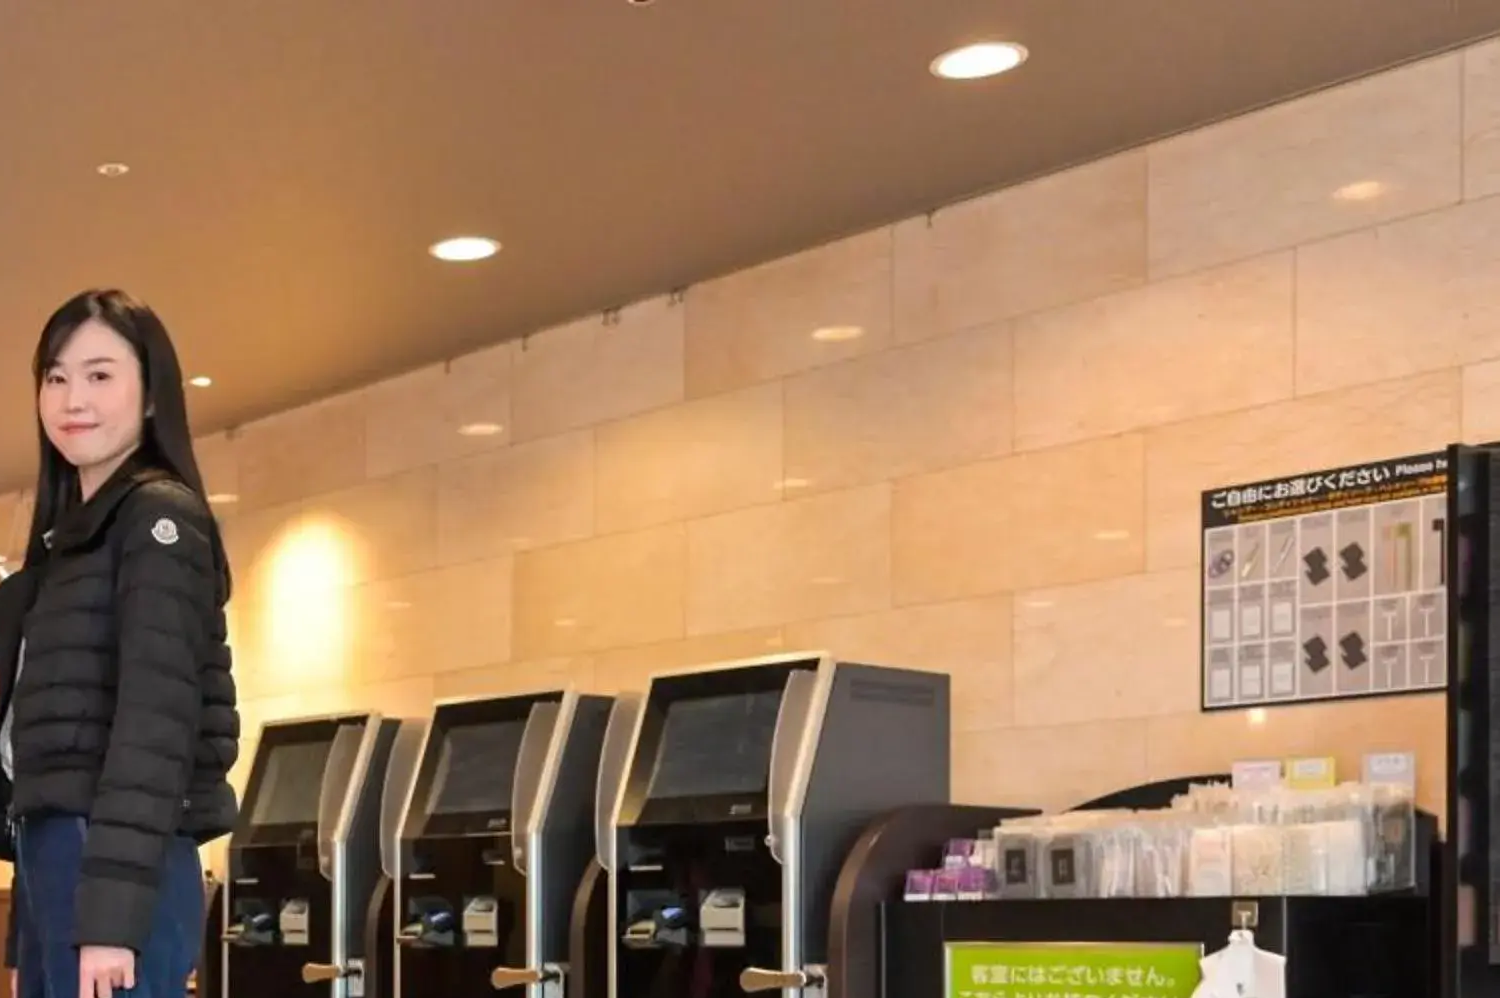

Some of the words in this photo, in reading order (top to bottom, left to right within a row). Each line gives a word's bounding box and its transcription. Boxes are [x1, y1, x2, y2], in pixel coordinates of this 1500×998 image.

[1395, 462, 1434, 477] Please
[1211, 466, 1391, 509] ご自由にお選びください
[971, 964, 1176, 989] 客室にはございません。
